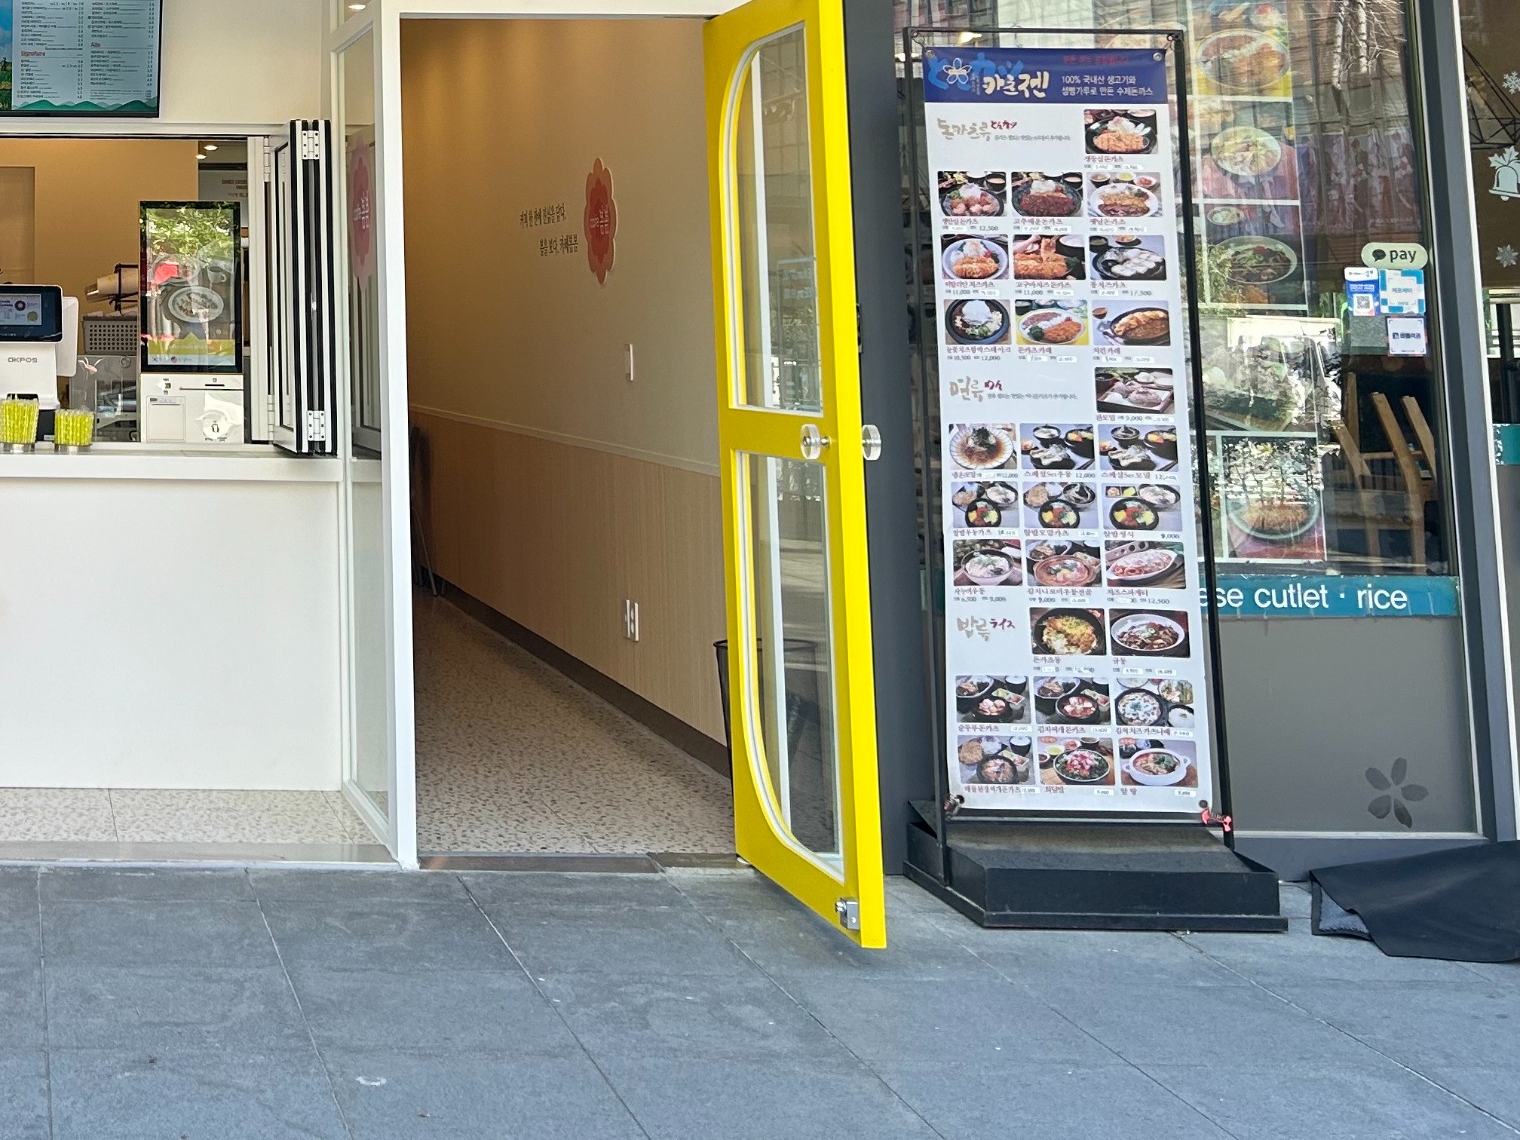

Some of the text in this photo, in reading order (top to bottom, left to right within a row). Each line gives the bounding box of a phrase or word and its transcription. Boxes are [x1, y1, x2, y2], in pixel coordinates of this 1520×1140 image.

[1062, 75, 1081, 84] 100%
[1083, 75, 1105, 85] 국내산
[1389, 249, 1417, 263] pay
[1254, 583, 1328, 608] cutlet
[1357, 584, 1408, 609] rice
